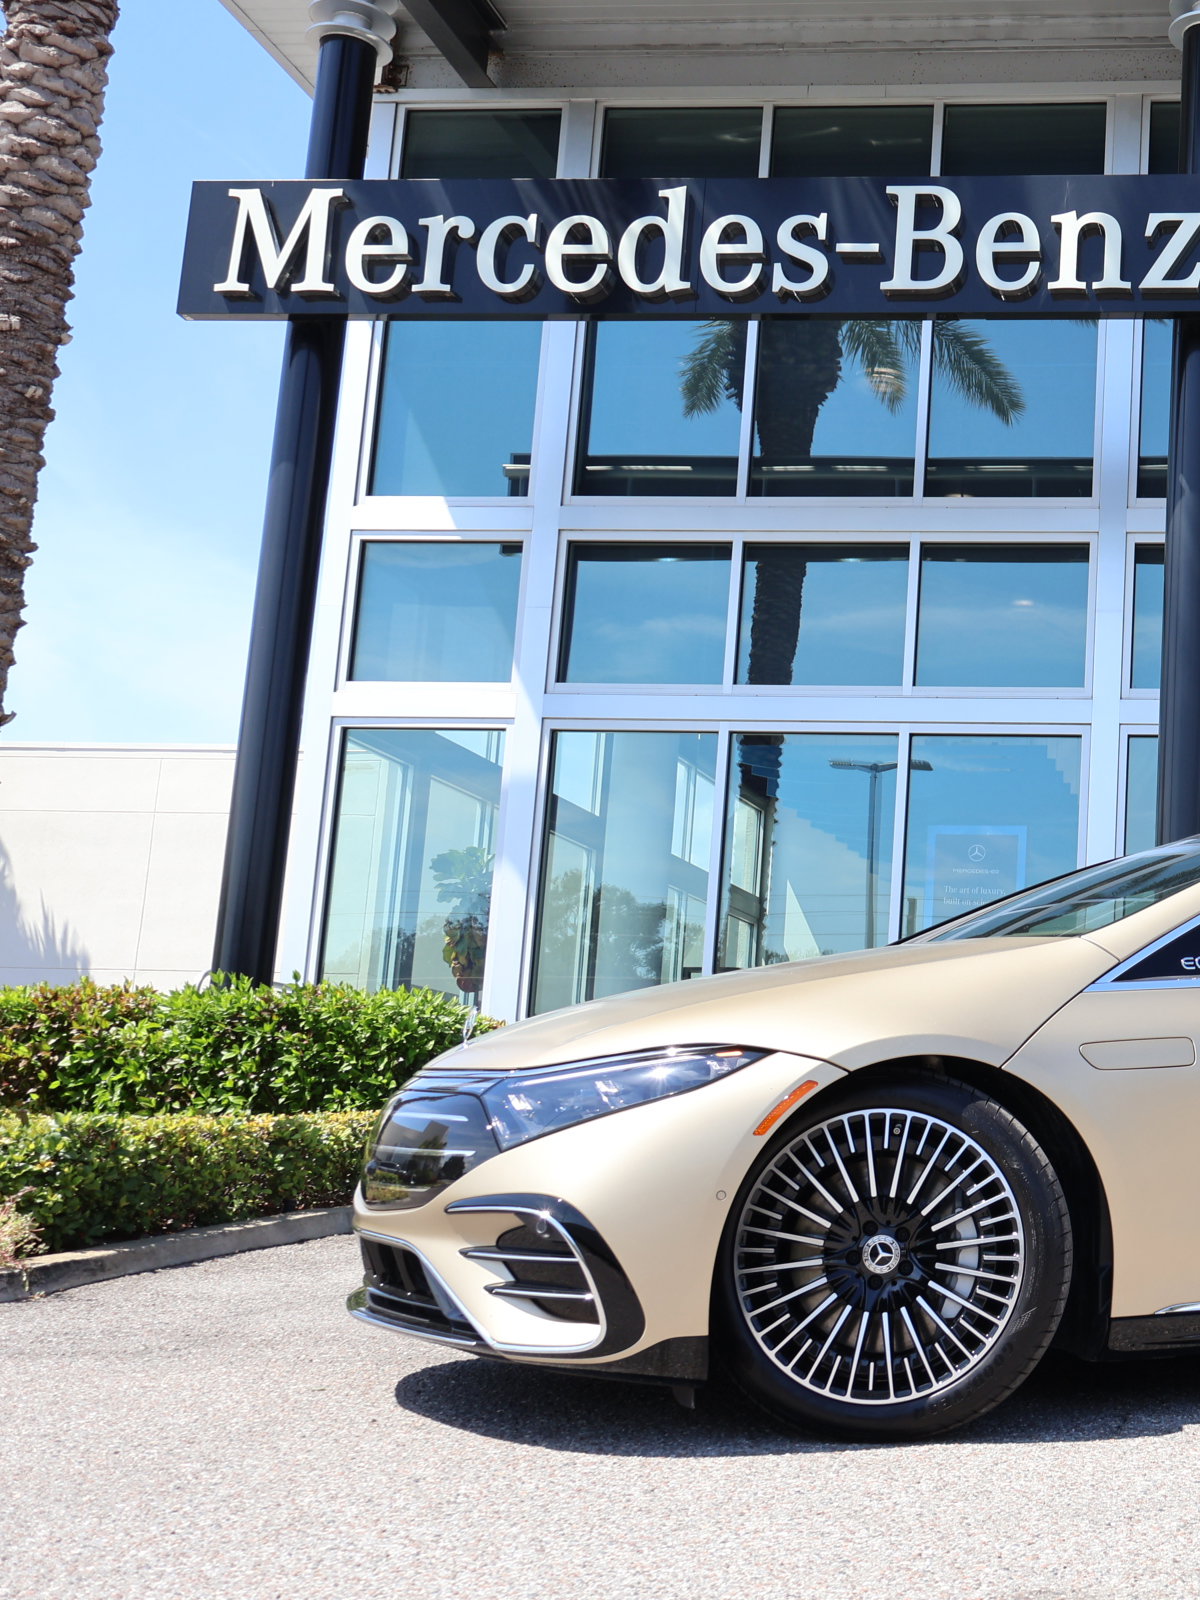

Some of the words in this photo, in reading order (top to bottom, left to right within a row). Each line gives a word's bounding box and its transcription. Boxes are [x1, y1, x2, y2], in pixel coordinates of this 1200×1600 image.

[944, 885, 958, 893] The
[959, 886, 970, 894] art
[971, 886, 979, 894] of
[943, 897, 960, 905] built
